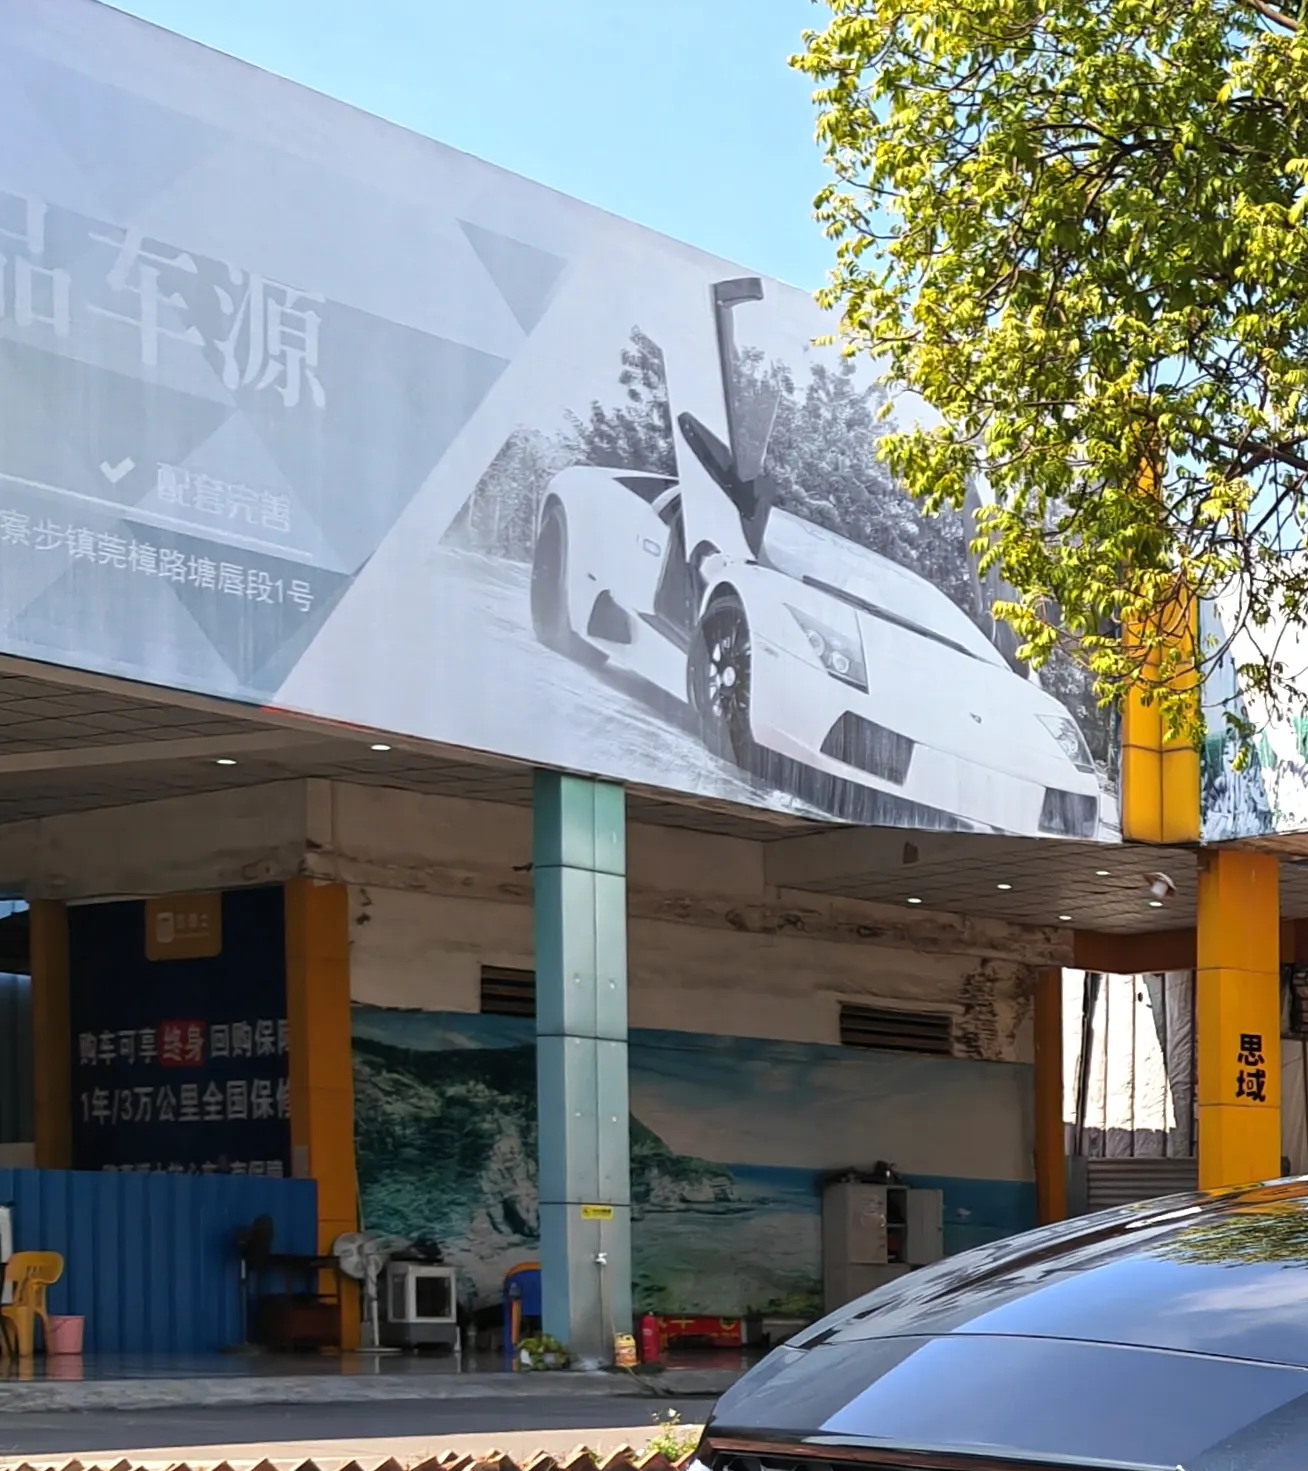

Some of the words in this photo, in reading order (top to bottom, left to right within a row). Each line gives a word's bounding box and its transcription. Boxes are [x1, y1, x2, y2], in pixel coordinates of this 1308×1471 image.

[156, 462, 292, 534] 配套完善
[1236, 1033, 1266, 1102] 思域
